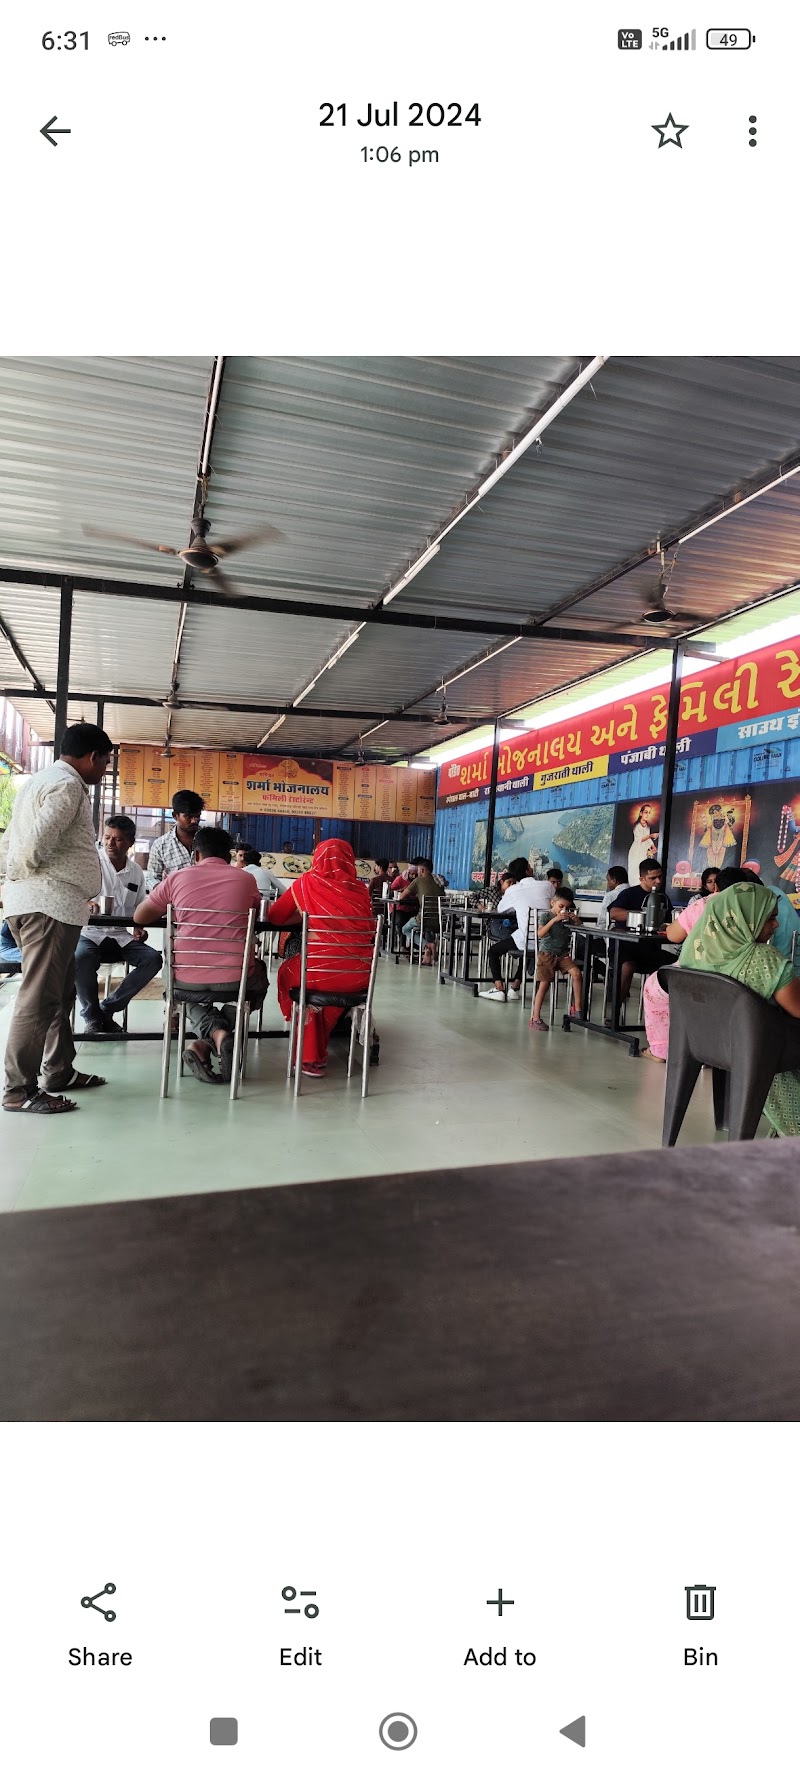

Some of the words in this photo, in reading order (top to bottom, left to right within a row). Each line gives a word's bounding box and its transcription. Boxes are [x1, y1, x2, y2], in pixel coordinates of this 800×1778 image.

[590, 704, 638, 747] અને
[737, 716, 786, 739] साउथ
[620, 745, 658, 765] पंजाबी
[512, 776, 530, 789] थाली
[540, 766, 571, 786] गुजराती
[571, 760, 594, 776] थाली
[246, 779, 270, 791] शर्मा
[273, 780, 330, 796] भोजनालय
